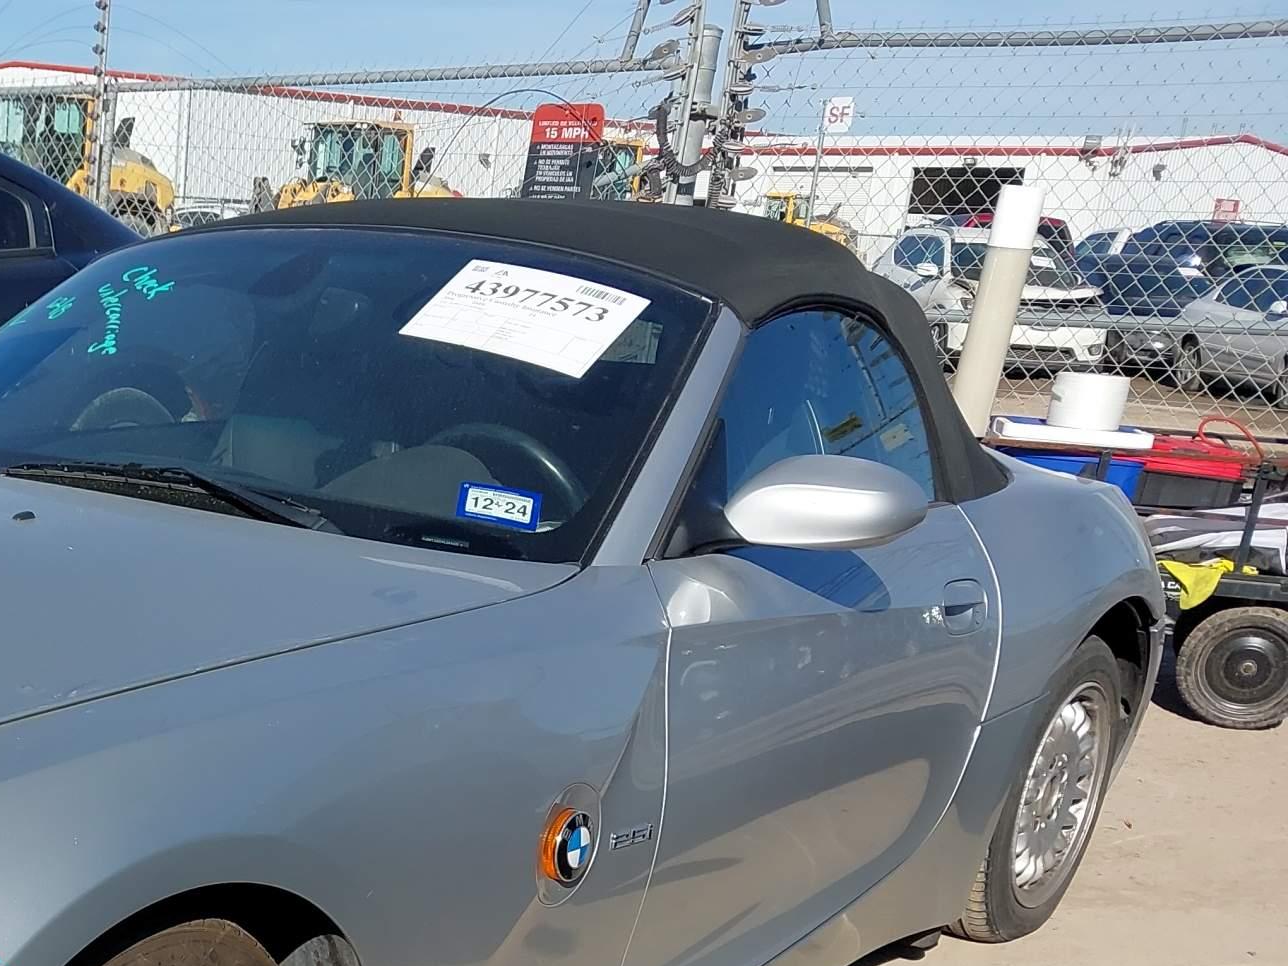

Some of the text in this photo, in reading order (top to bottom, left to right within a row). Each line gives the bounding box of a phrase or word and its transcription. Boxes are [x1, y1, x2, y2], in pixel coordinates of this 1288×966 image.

[828, 106, 851, 124] SF
[545, 127, 589, 139] 15 MPH
[464, 279, 610, 323] 43977573
